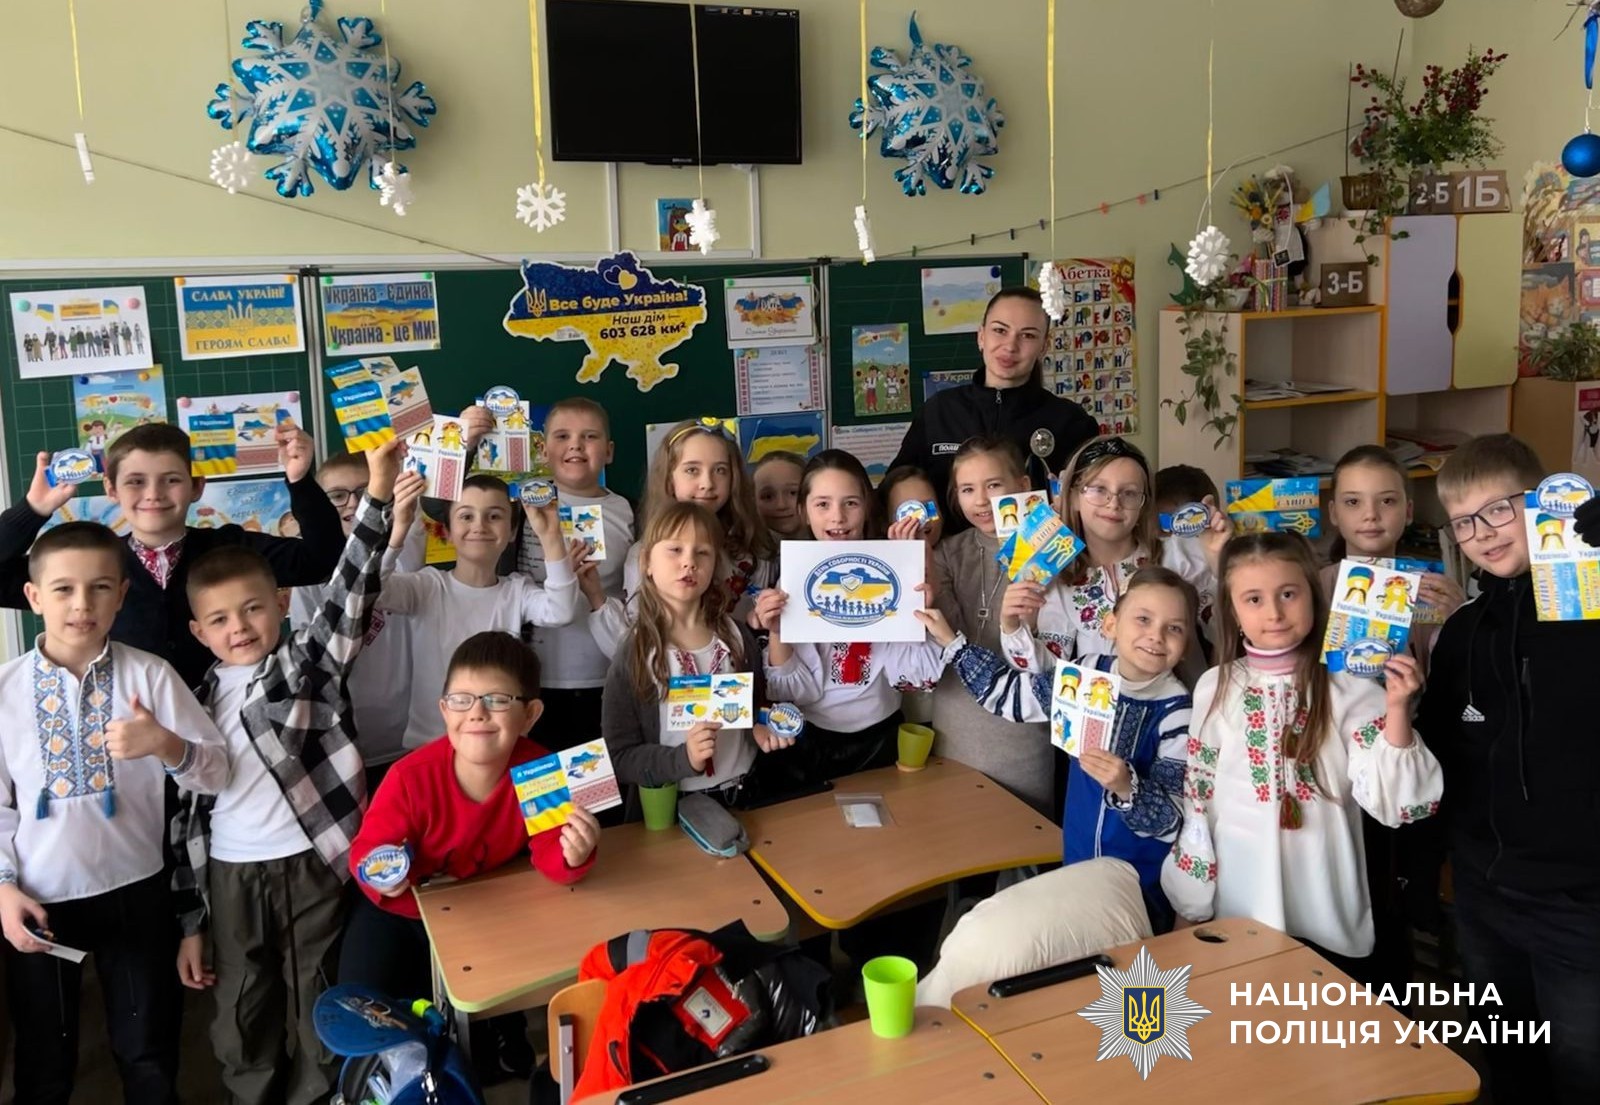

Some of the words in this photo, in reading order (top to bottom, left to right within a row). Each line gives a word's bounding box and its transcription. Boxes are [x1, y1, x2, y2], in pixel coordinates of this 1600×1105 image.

[1457, 176, 1500, 207] 1Б
[1058, 265, 1111, 280] Абетка
[1327, 271, 1363, 295] 3-Б
[191, 289, 233, 302] СЛАВА
[237, 285, 286, 300] УКРАЇНІ!
[324, 284, 377, 305] Україна
[387, 282, 434, 302] Єдина!
[549, 298, 578, 311] Все
[582, 295, 620, 309] буде
[624, 290, 689, 308] Україна!
[612, 314, 642, 325] Наш
[645, 312, 665, 324] дім
[196, 338, 243, 351] ГЕРОЯМ
[248, 334, 291, 348] СЛАВА!
[330, 322, 383, 346] Україна
[393, 324, 410, 342] це
[412, 320, 437, 341] МИ!
[600, 327, 626, 340] 603
[630, 326, 656, 338] 628
